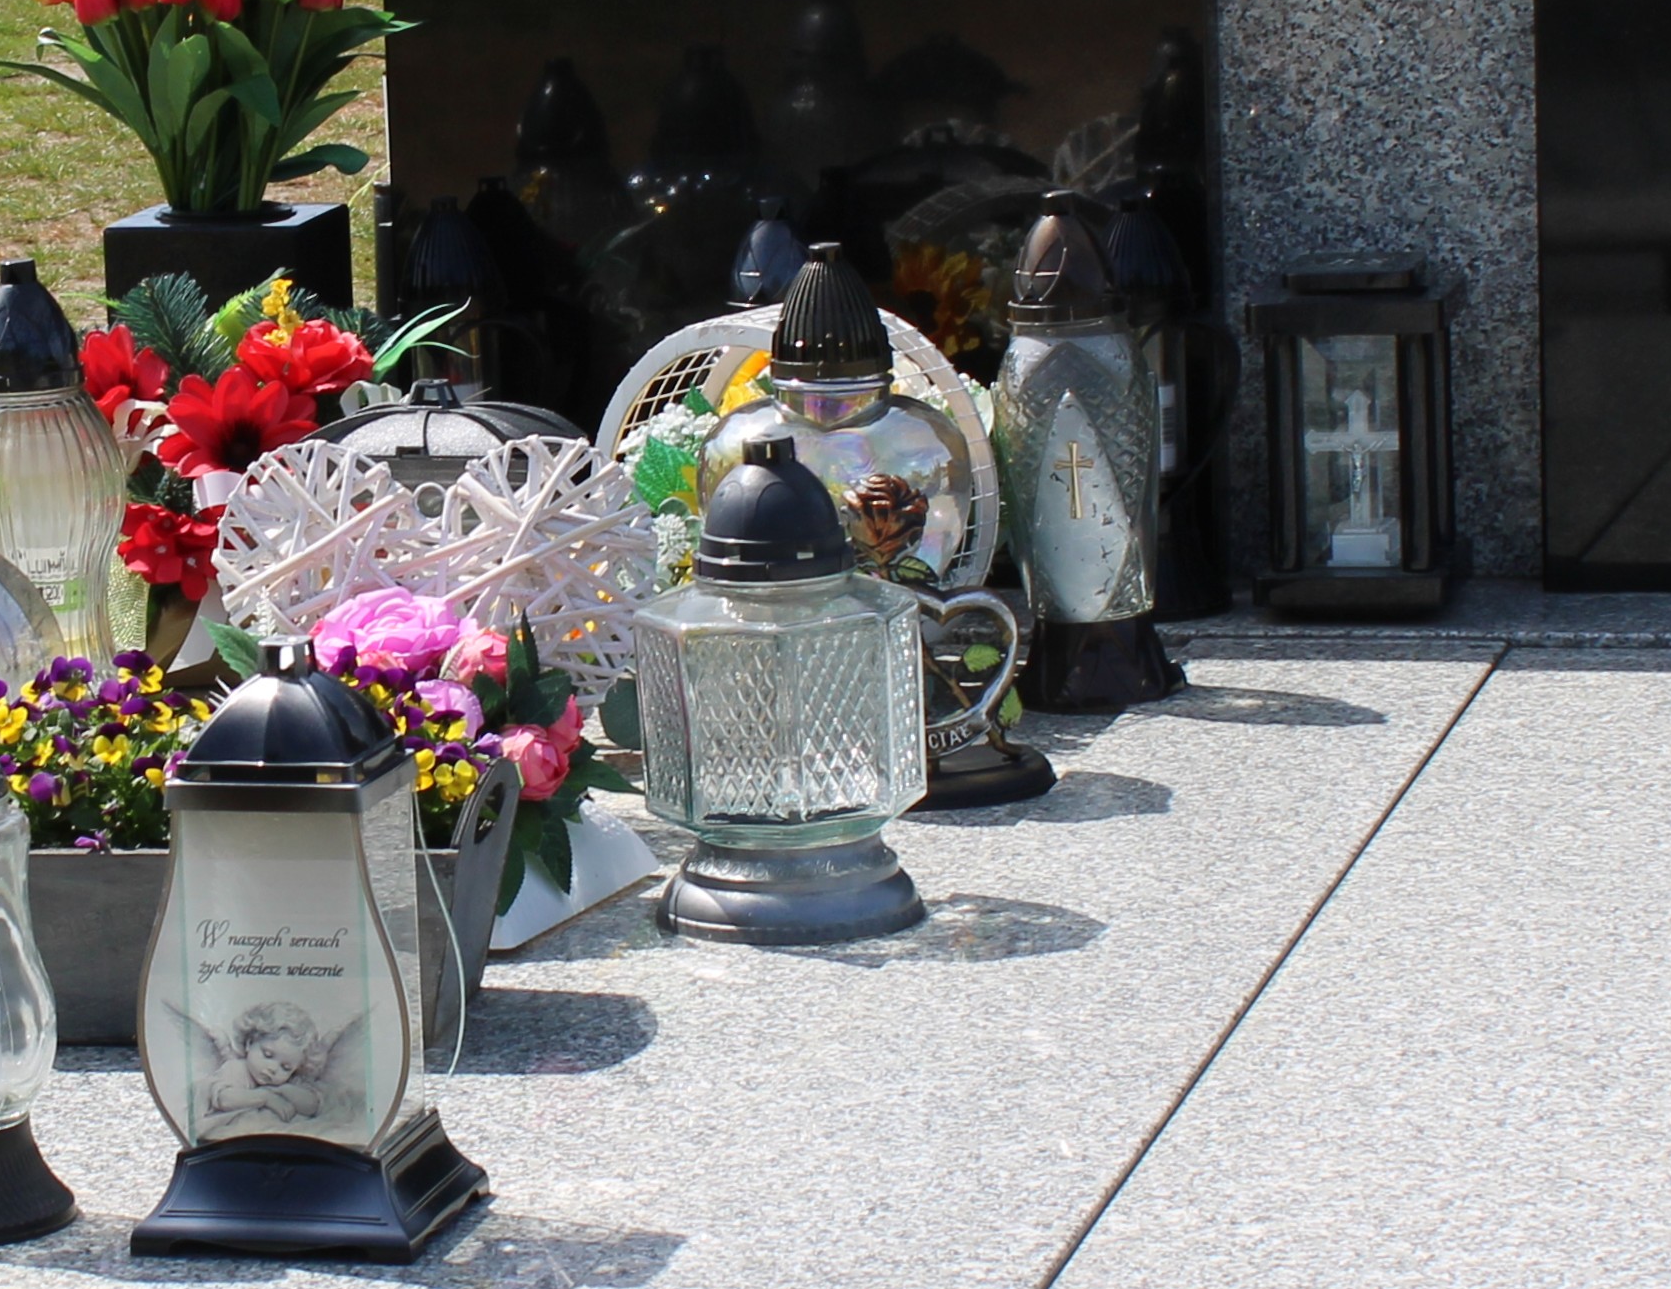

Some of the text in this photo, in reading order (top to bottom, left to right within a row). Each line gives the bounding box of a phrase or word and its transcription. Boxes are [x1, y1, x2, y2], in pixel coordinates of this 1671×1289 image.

[196, 919, 348, 956] W naszych sercach
[197, 954, 345, 983] żyć będziesz wiecznie
